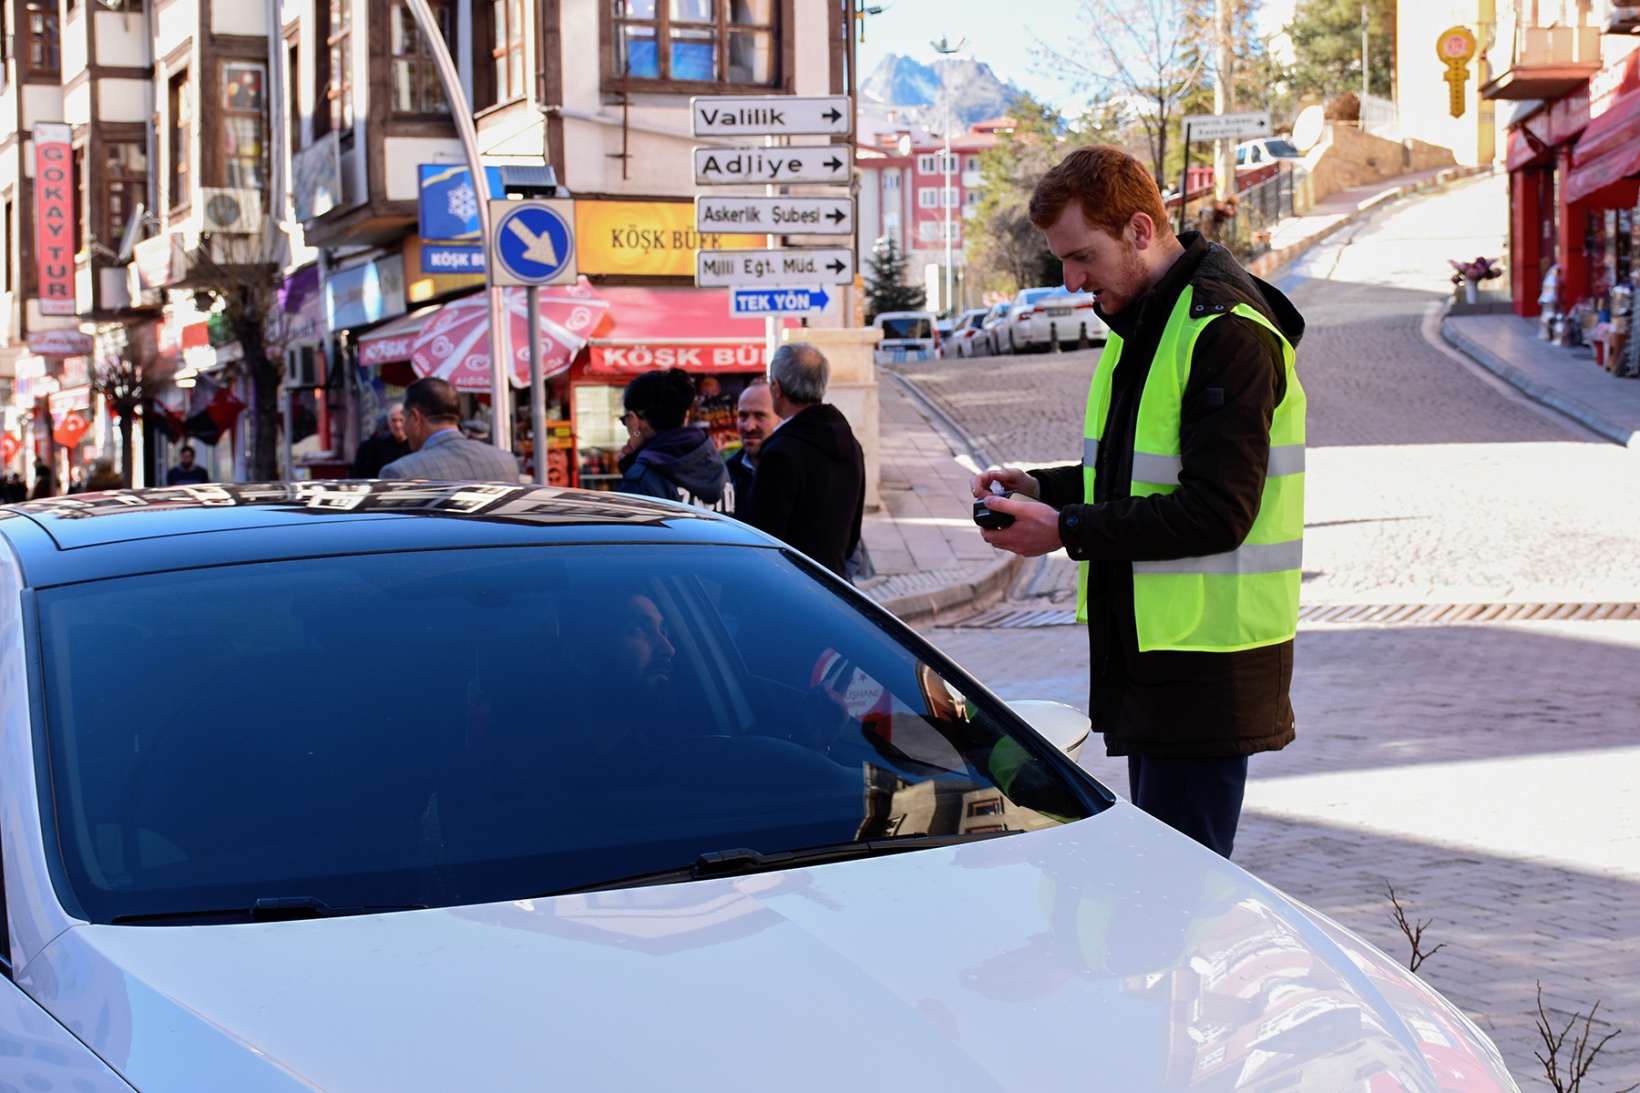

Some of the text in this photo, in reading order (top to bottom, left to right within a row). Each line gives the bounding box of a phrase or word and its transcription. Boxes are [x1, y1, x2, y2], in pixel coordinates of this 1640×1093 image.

[700, 108, 785, 126] Valilik
[702, 154, 803, 178] Adliye
[703, 205, 821, 224] Askerlik Şubesi
[611, 224, 665, 254] KÖŞK
[47, 246, 68, 298] TUR
[783, 258, 818, 274] Müd.
[737, 291, 810, 311] TEK YÖN
[603, 345, 703, 369] KÖŞK
[713, 345, 767, 366] BÜ
